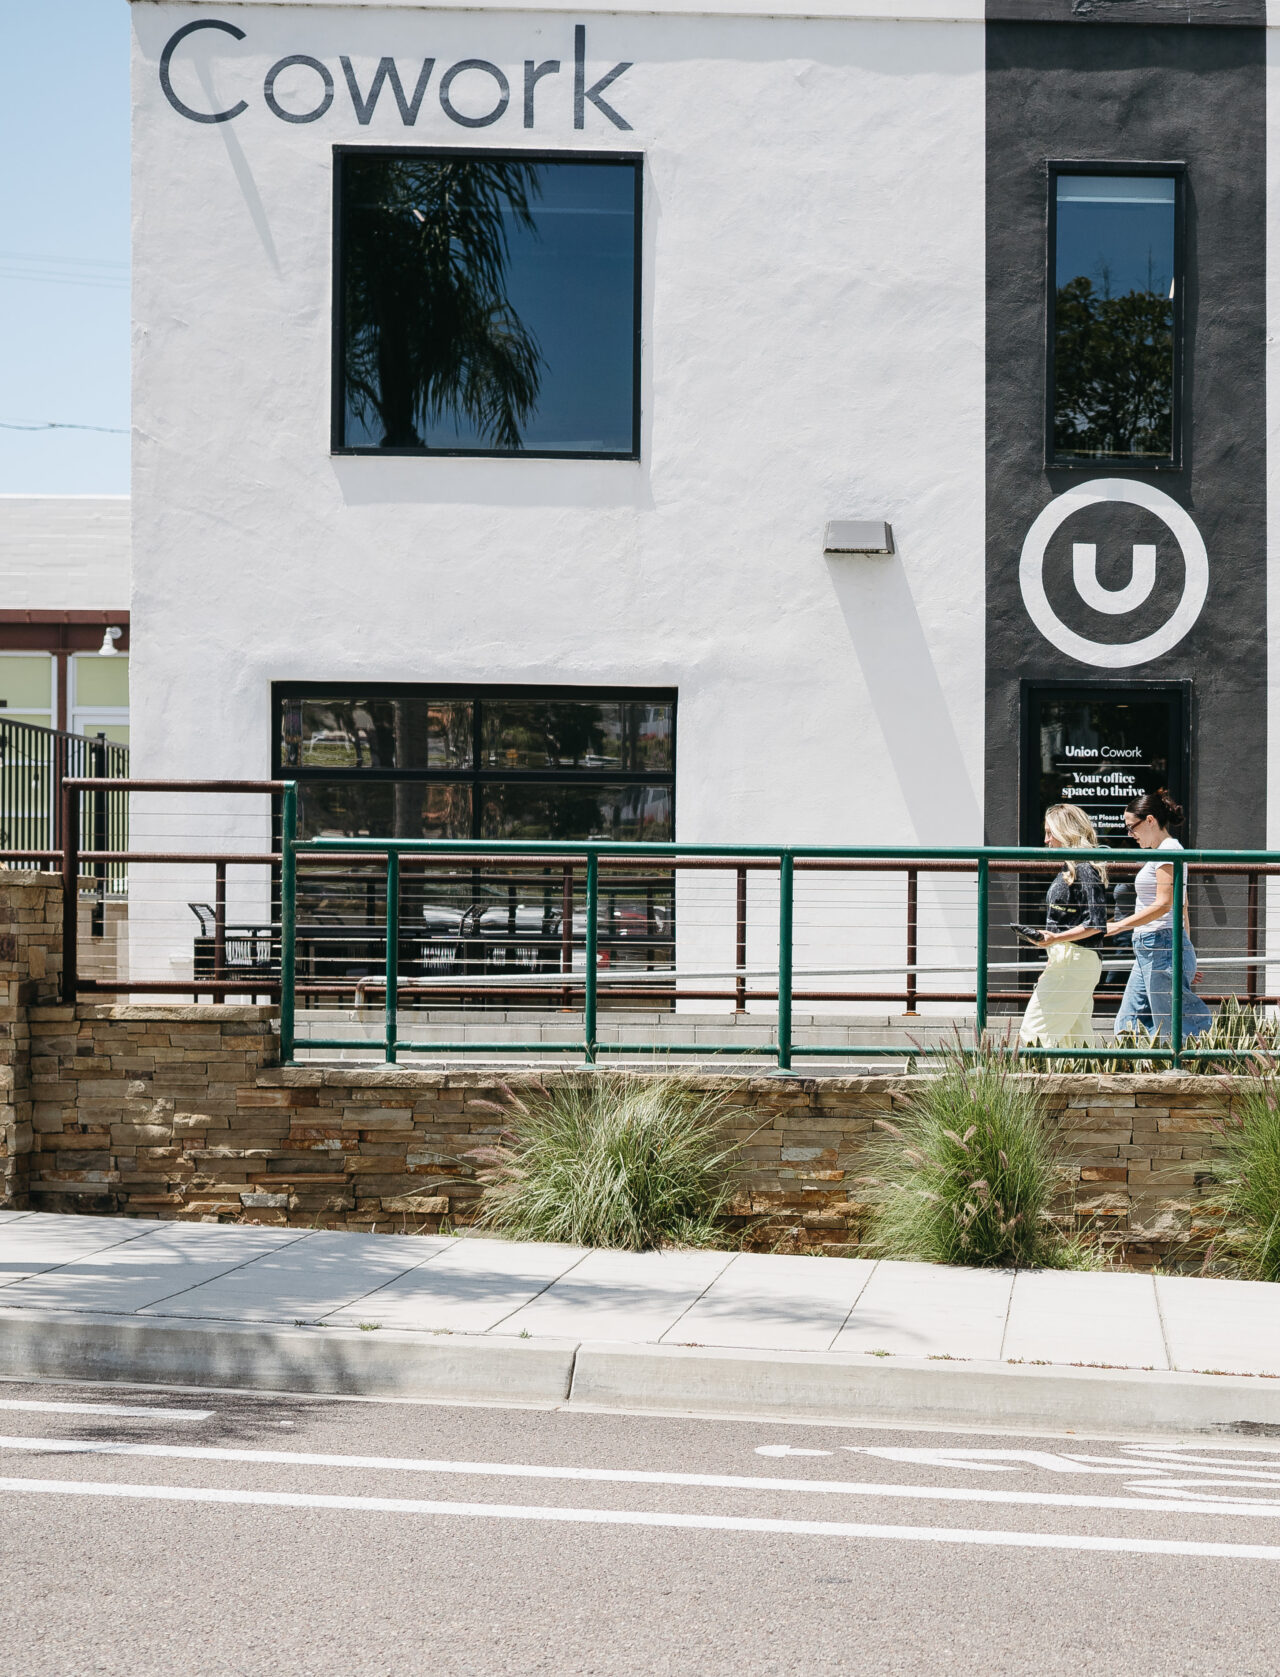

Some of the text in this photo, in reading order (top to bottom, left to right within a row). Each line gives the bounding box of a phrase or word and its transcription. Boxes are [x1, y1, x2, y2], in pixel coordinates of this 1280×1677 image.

[159, 18, 634, 131] Cowork
[1065, 745, 1142, 758] Union Cowork
[1072, 772, 1136, 784] Your office
[1061, 785, 1146, 799] space to thrive
